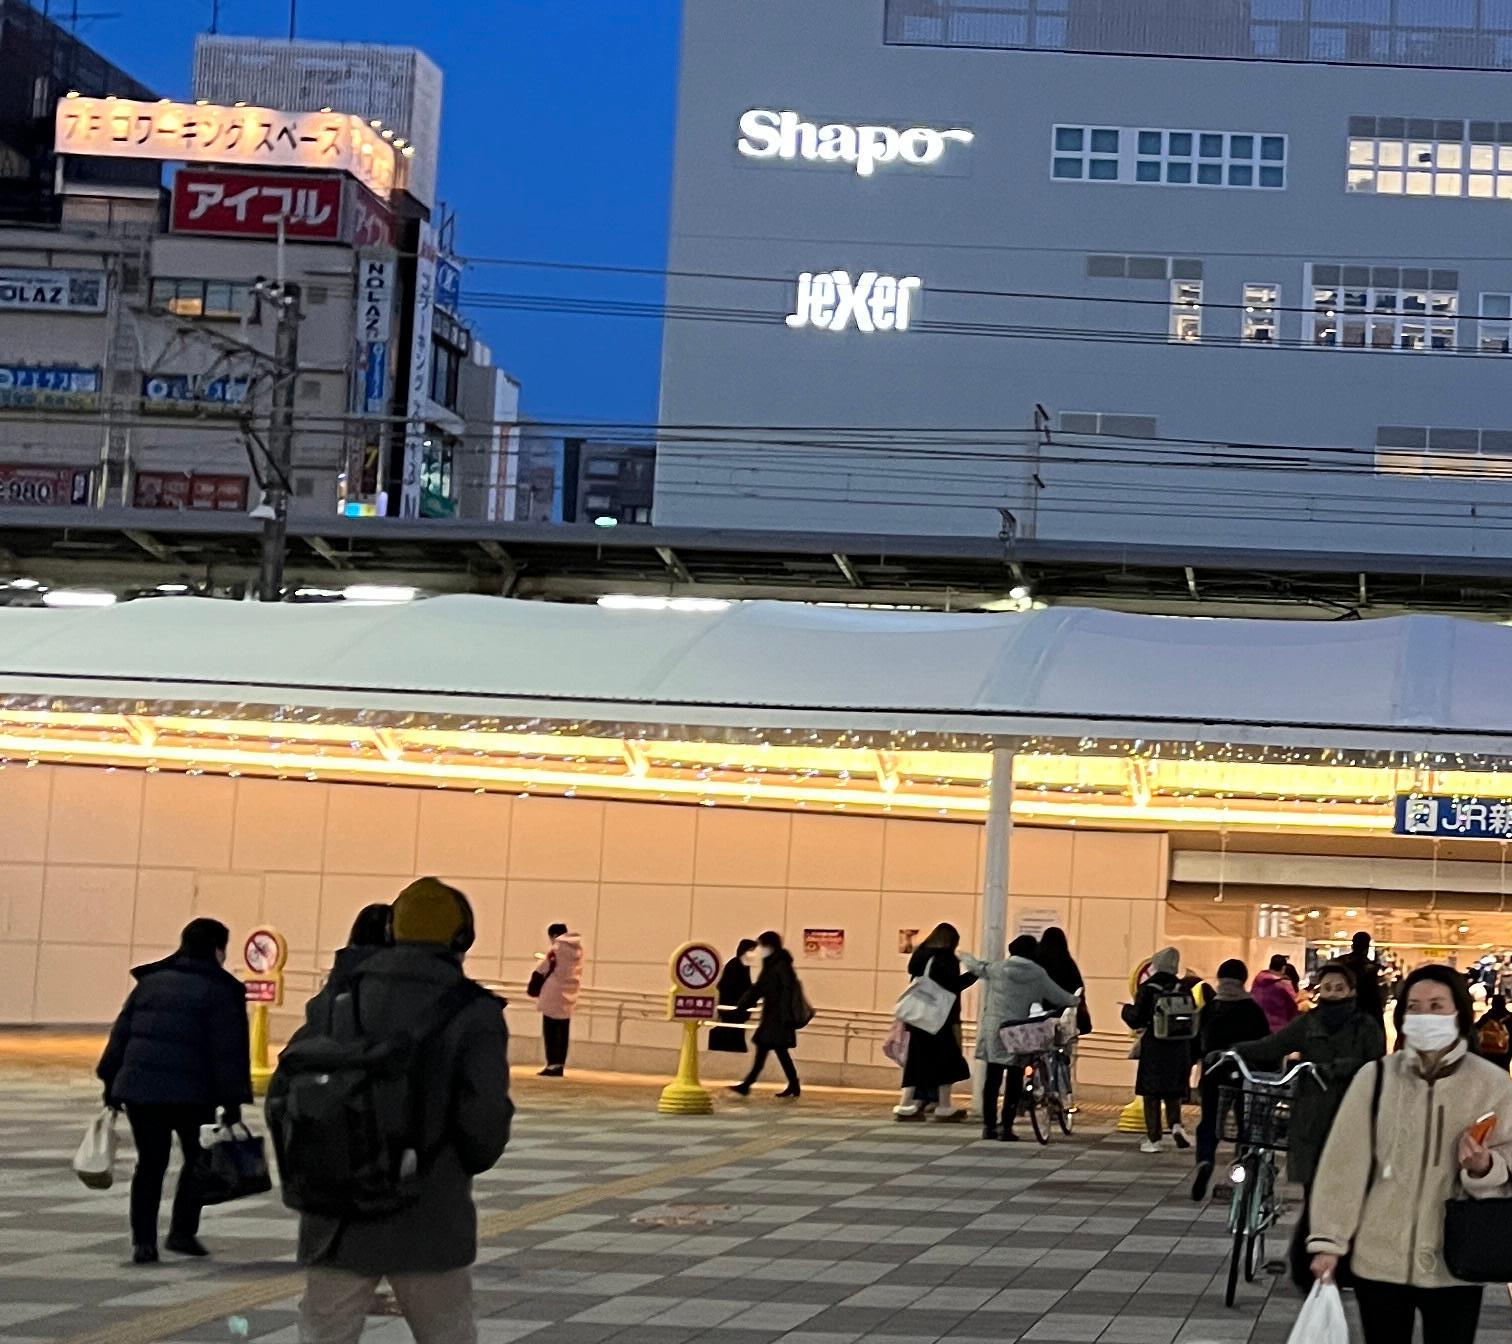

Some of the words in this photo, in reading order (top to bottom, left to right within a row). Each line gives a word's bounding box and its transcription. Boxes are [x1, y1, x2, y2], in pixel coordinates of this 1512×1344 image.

[738, 109, 975, 176] Shapo
[187, 182, 331, 225] アイフル
